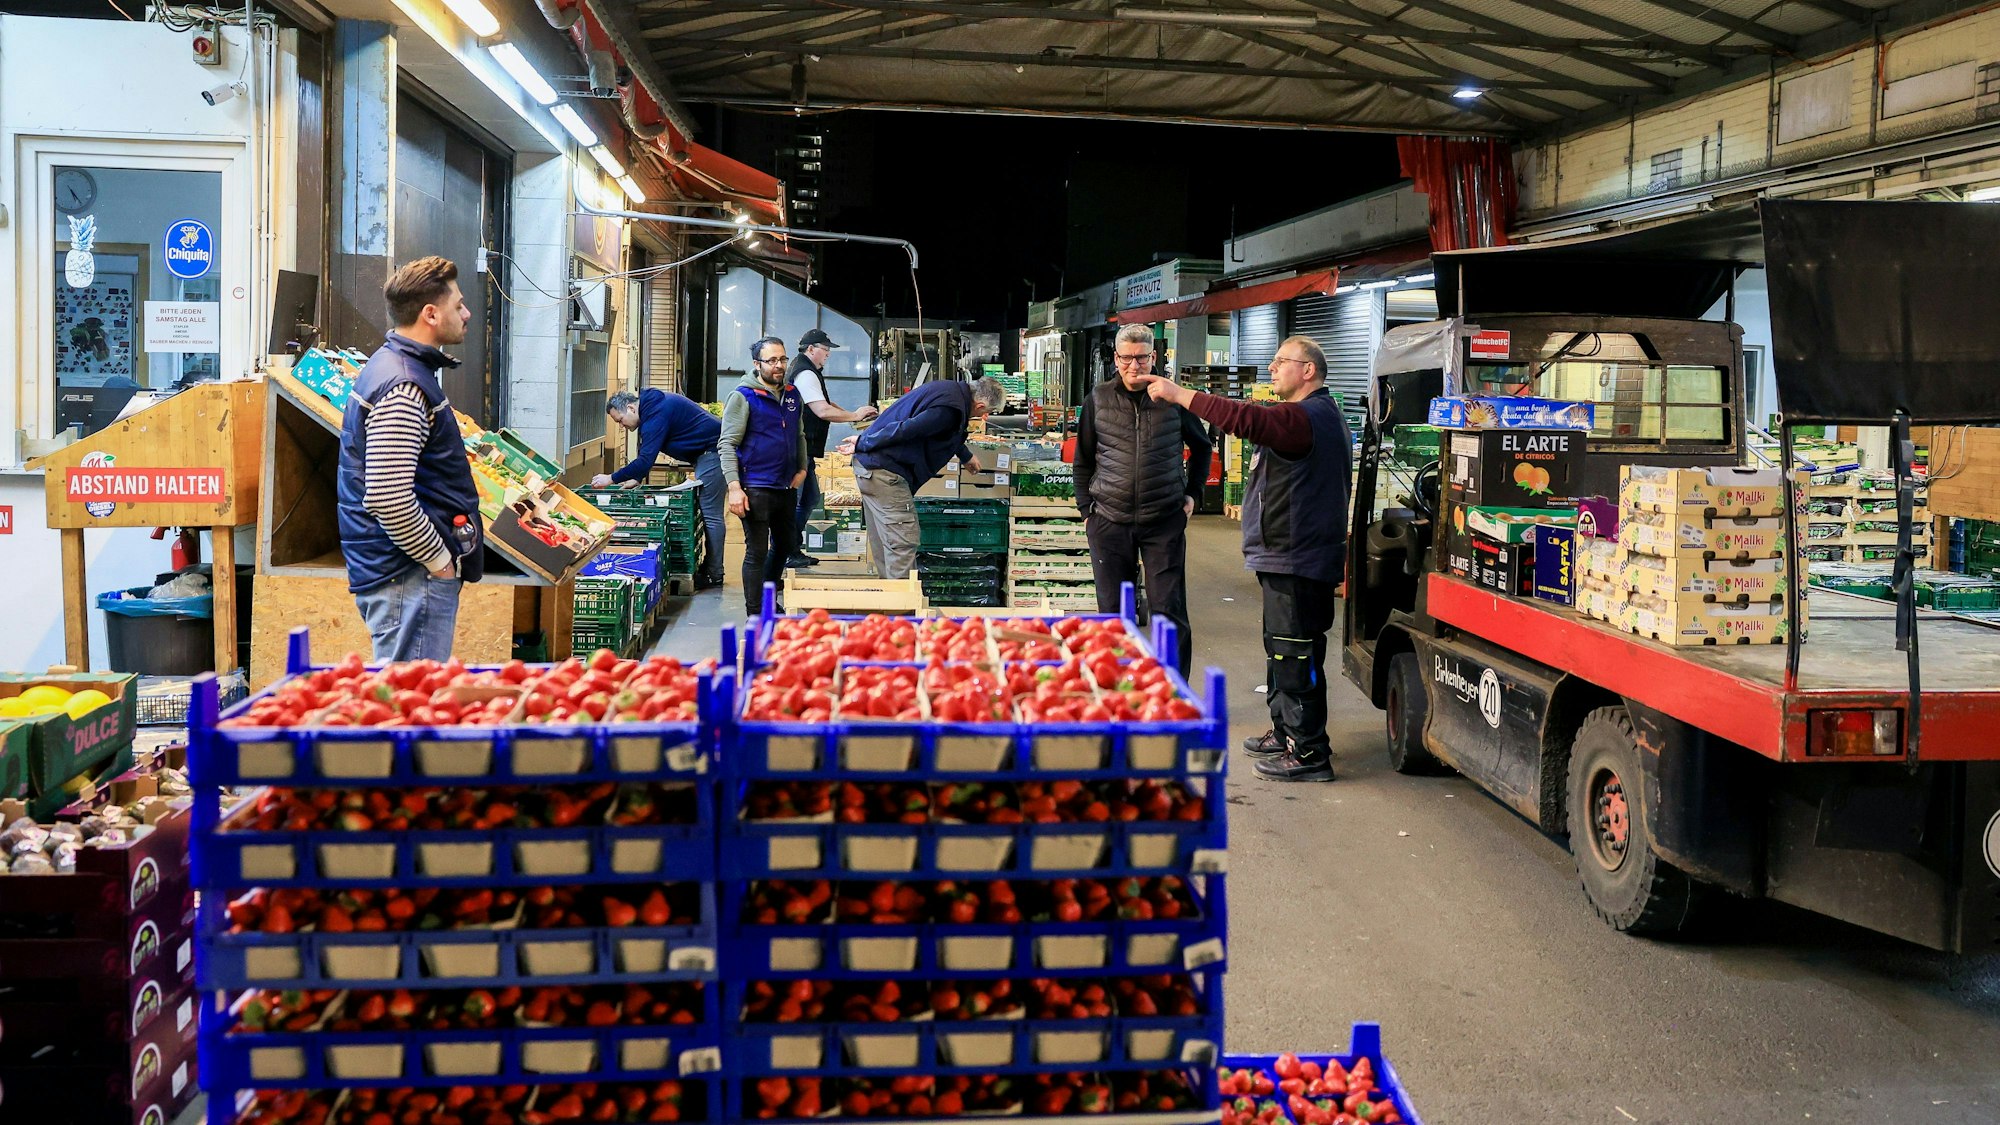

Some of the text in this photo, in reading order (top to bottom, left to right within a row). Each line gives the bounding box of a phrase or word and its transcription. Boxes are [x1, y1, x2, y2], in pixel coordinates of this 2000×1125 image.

[168, 247, 209, 263] Chiquita
[1127, 284, 1143, 298] PETER
[61, 394, 94, 402] ASUS
[1502, 435, 1569, 452] EL ARTE
[69, 474, 220, 495] ABSTAND HALTEN
[1736, 491, 1765, 505] Mallki
[1734, 534, 1764, 549] Mallki
[1559, 540, 1570, 586] SAFTA
[1734, 577, 1764, 592] Mallki
[1735, 620, 1764, 635] Mallki
[1483, 679, 1496, 718] 20
[74, 710, 120, 755] DULCE
